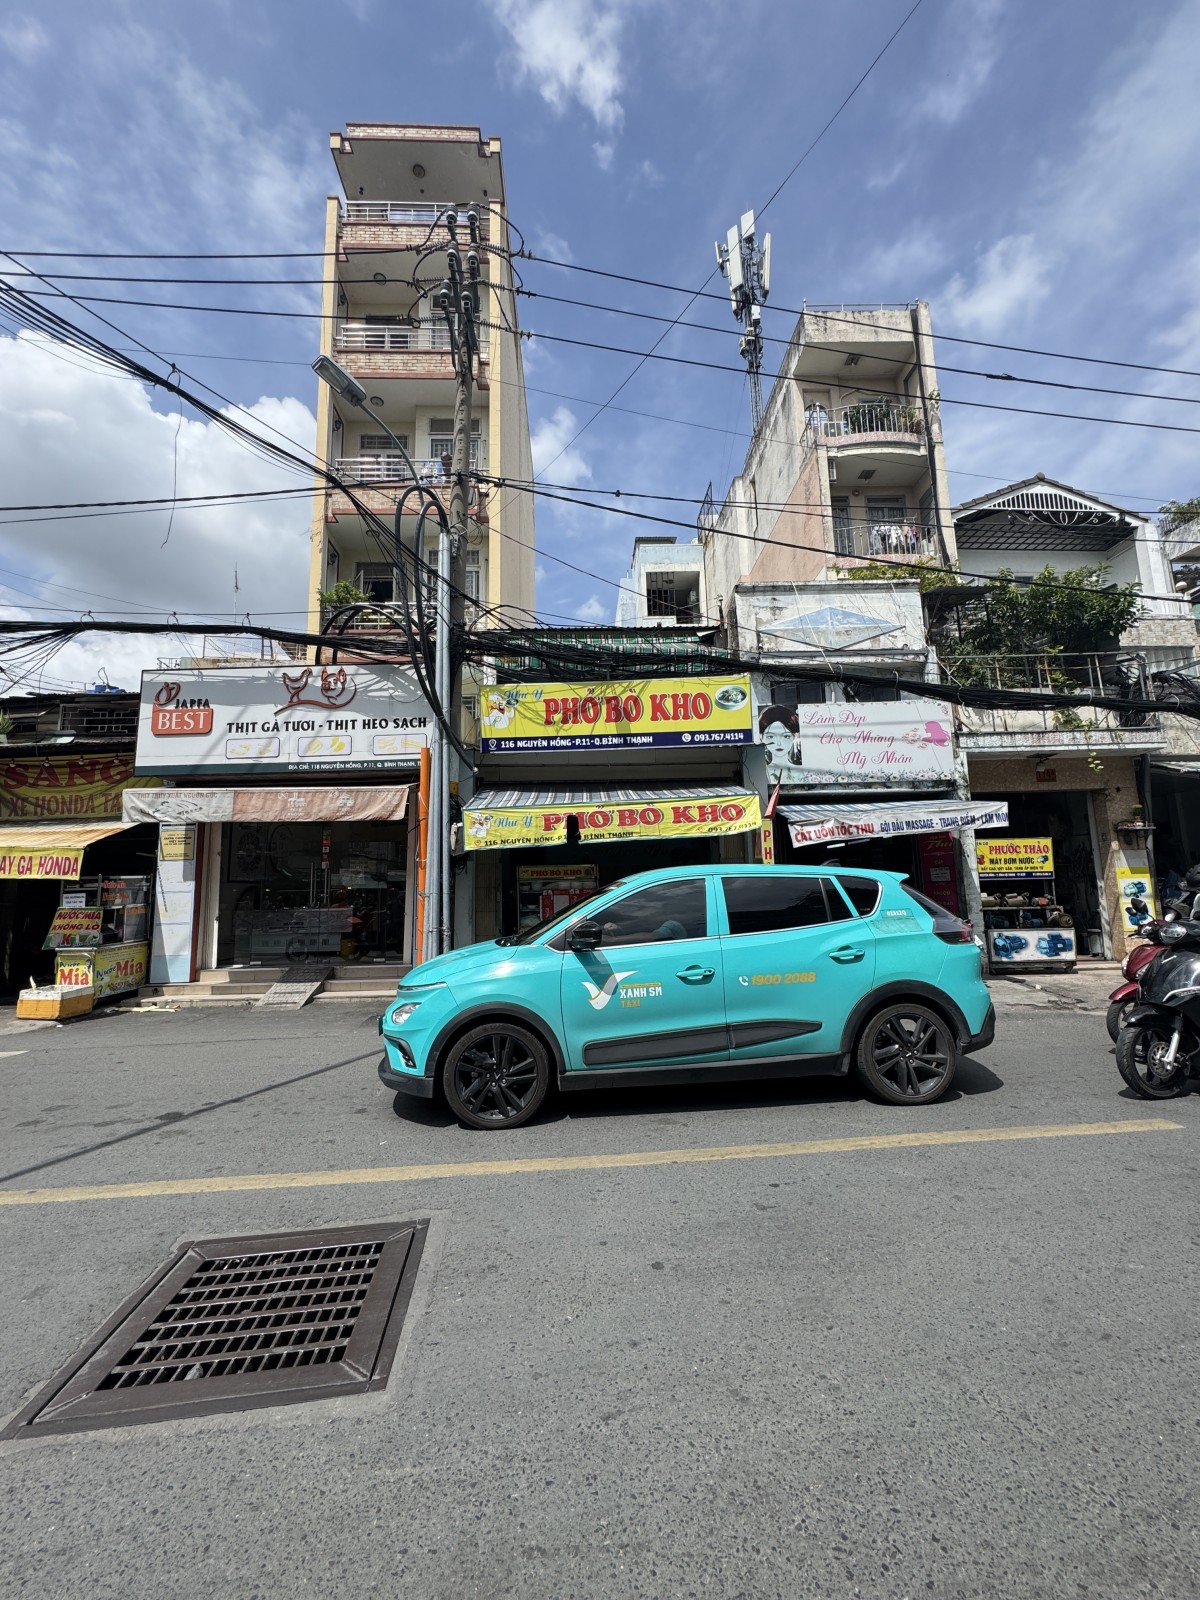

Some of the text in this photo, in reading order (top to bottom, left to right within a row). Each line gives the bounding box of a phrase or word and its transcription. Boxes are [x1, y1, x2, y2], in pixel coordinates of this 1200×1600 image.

[174, 698, 210, 709] JAPFA
[543, 687, 712, 725] PHỞ BÒ KHO
[157, 711, 209, 730] BEST
[226, 721, 258, 736] THỊT
[261, 719, 280, 733] GÀ
[284, 719, 316, 732] TƯƠI
[326, 718, 358, 733] THỊT
[362, 717, 389, 730] HEO
[393, 717, 427, 731] SẠCH
[802, 709, 867, 728] Làm Đẹp
[500, 740, 515, 748] 116
[625, 735, 653, 746] THẠNH
[694, 733, 744, 742] 093.767.4114
[819, 730, 896, 748] Cho Những
[836, 750, 913, 770] Mỹ Nhân
[8, 797, 28, 818] XE
[33, 793, 97, 816] HONDA
[617, 803, 663, 827] BÒ
[671, 803, 745, 825] KHO
[905, 818, 935, 830] MASSAGE
[939, 816, 960, 828] TRANG
[981, 812, 995, 825] LÀM
[836, 821, 854, 836] TÓC
[854, 822, 875, 834] THU
[988, 841, 1050, 855] PHƯỚC THẢO
[17, 855, 33, 876] GA
[37, 856, 79, 877] HONDA
[989, 855, 1035, 865] MÁY BƠM NƯỚC
[58, 967, 90, 986] Mía
[115, 959, 144, 979] Mía
[751, 971, 817, 985] 1900 2088
[620, 986, 663, 998] XANH SM
